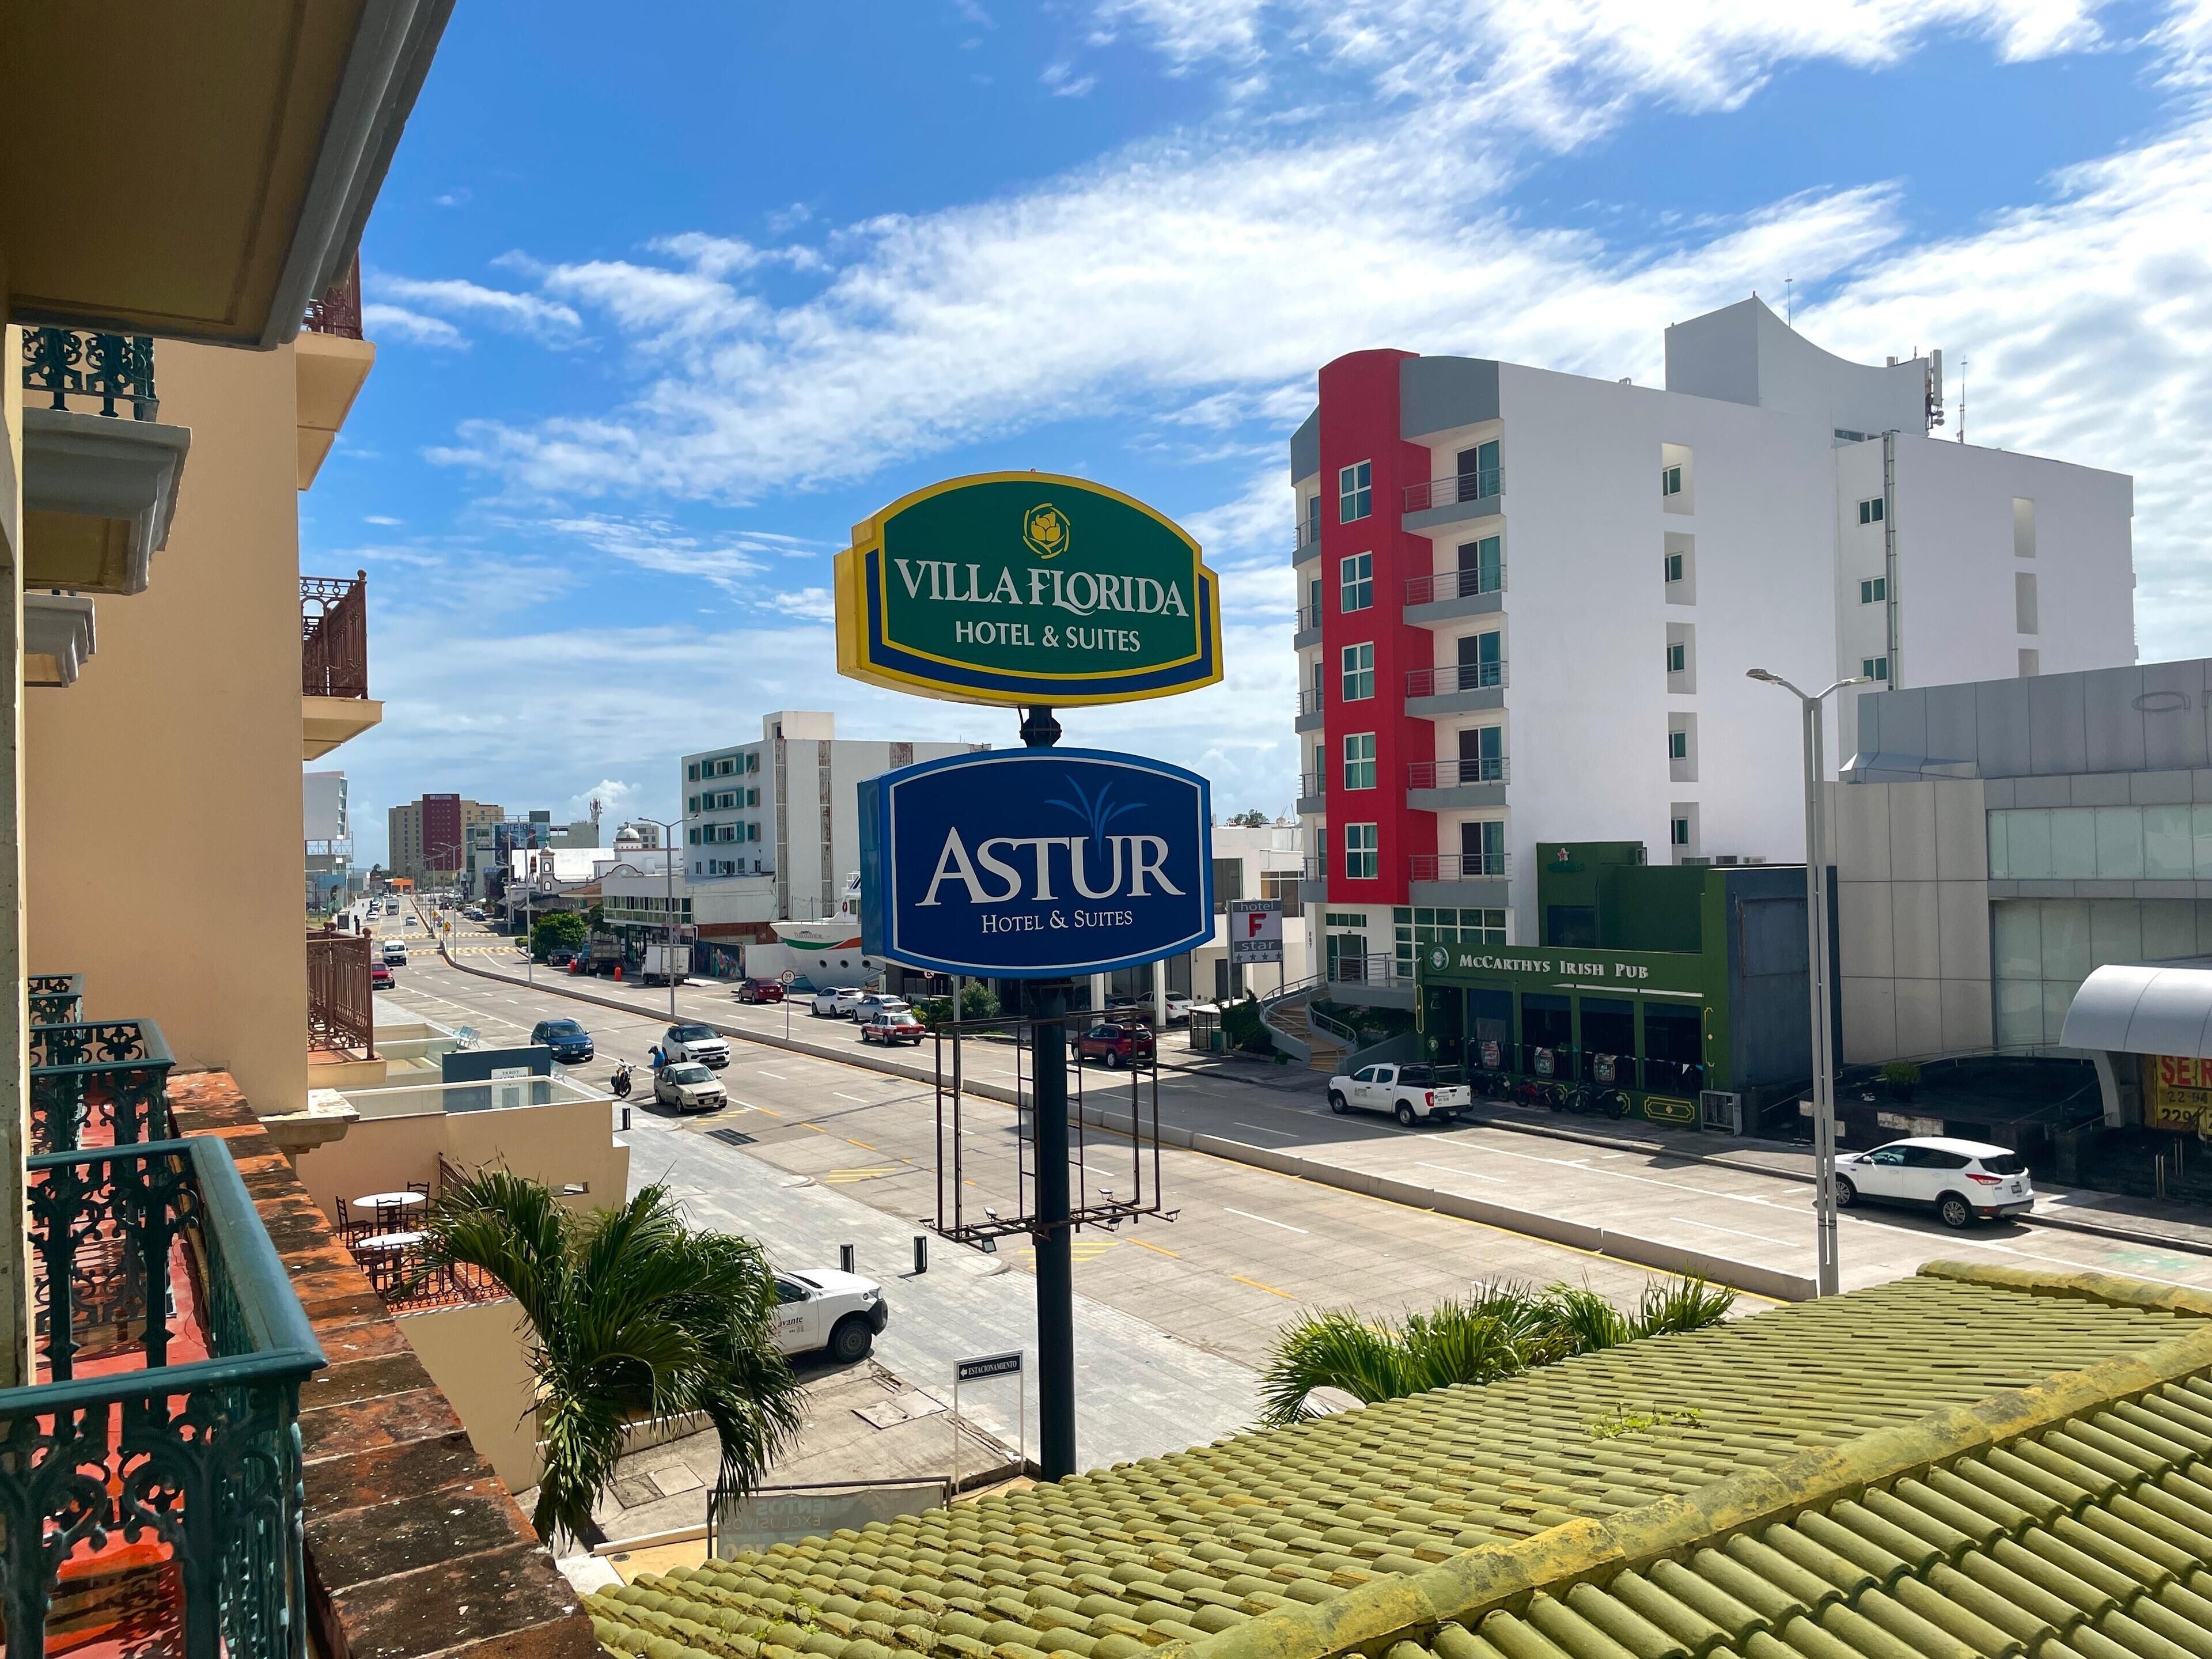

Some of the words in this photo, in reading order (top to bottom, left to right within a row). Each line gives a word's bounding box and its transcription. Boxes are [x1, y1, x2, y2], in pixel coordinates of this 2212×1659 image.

[894, 558, 1023, 605] VILLA
[1027, 568, 1189, 617] FLORIDA
[956, 621, 1035, 646] HOTEL
[1042, 626, 1059, 647] &
[1066, 626, 1141, 652] SUITES
[915, 827, 1185, 906] ASTUR
[1241, 901, 1273, 911] hotel
[982, 914, 1044, 933] HOTEL
[1050, 910, 1069, 929] &
[1074, 910, 1132, 928] SUITES
[1248, 913, 1267, 937] F
[1241, 941, 1275, 950] star
[1560, 960, 1605, 976] IRISH
[1615, 963, 1649, 978] PUB
[2161, 1055, 2192, 1085] SE
[778, 1316, 803, 1327] avante
[968, 1360, 1017, 1375] ESTACIONAMIENTO
